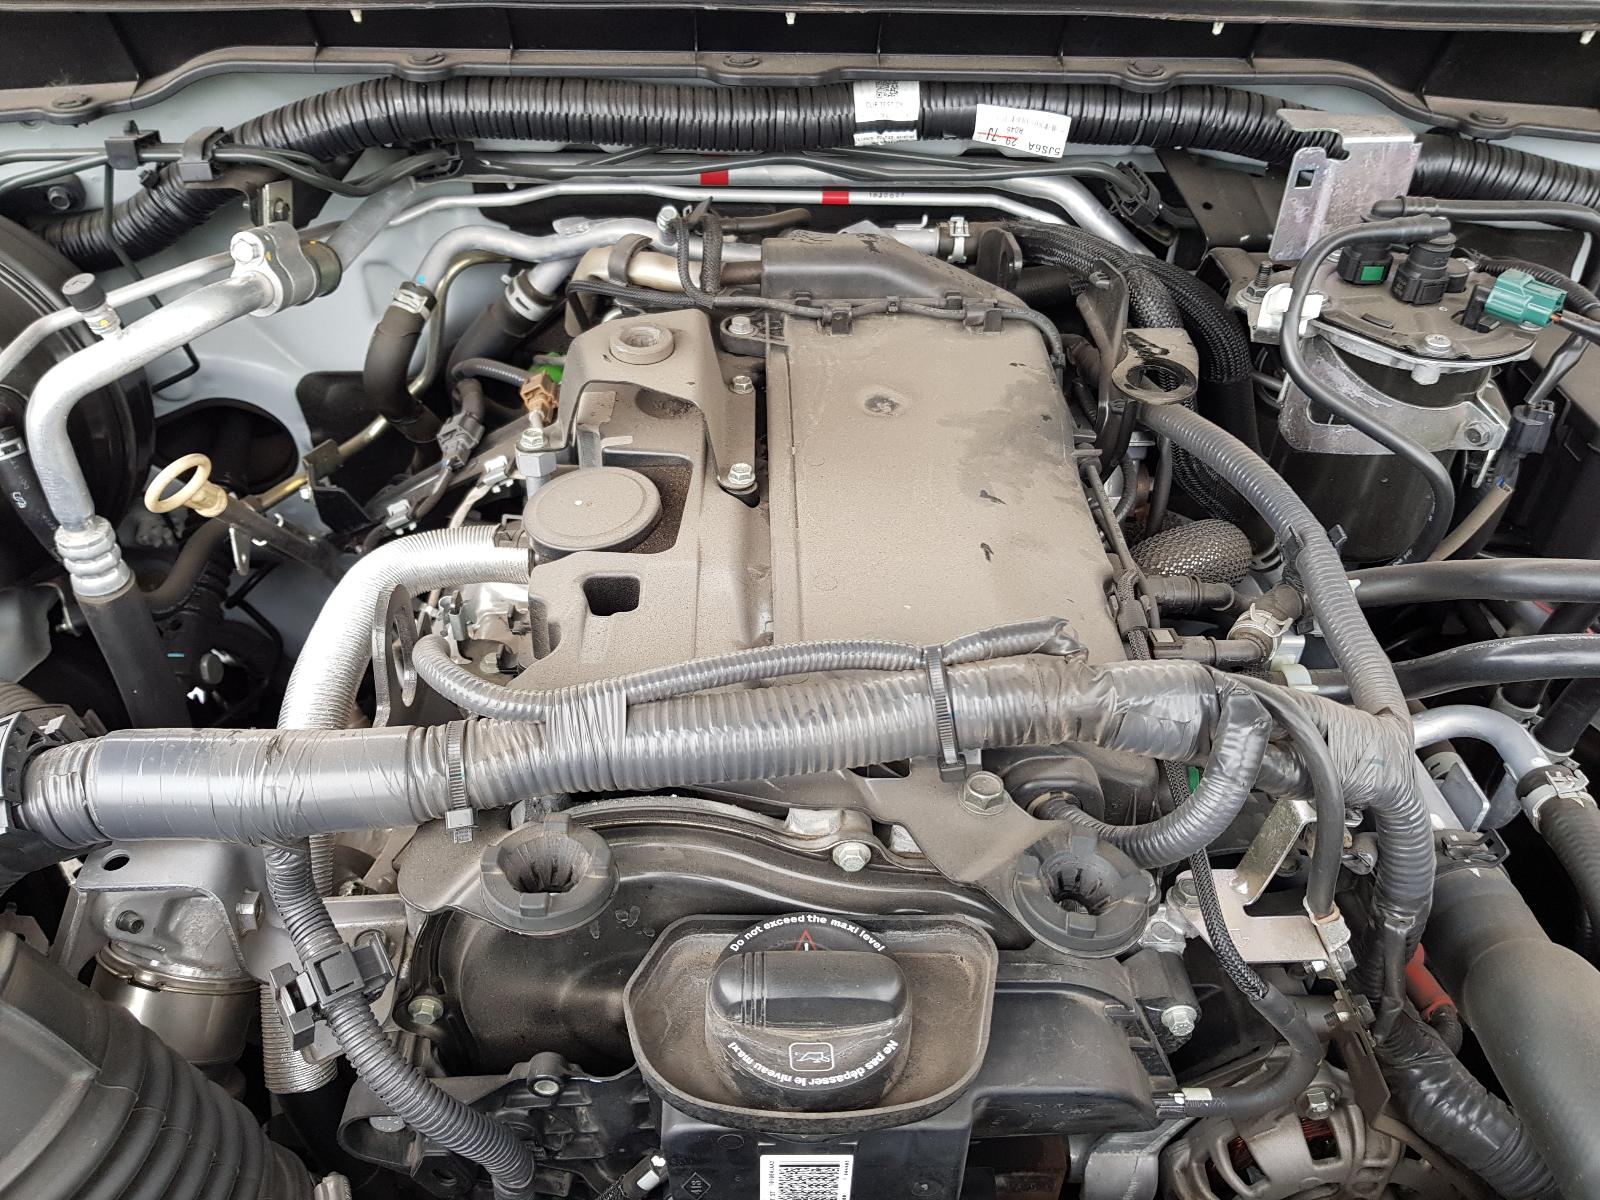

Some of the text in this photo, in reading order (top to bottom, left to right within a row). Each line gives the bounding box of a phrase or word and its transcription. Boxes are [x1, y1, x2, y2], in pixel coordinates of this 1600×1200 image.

[729, 914, 887, 952] Do not exceed the maxi level
[727, 1038, 899, 1087] Ne pas dépasser le niveau maxi
